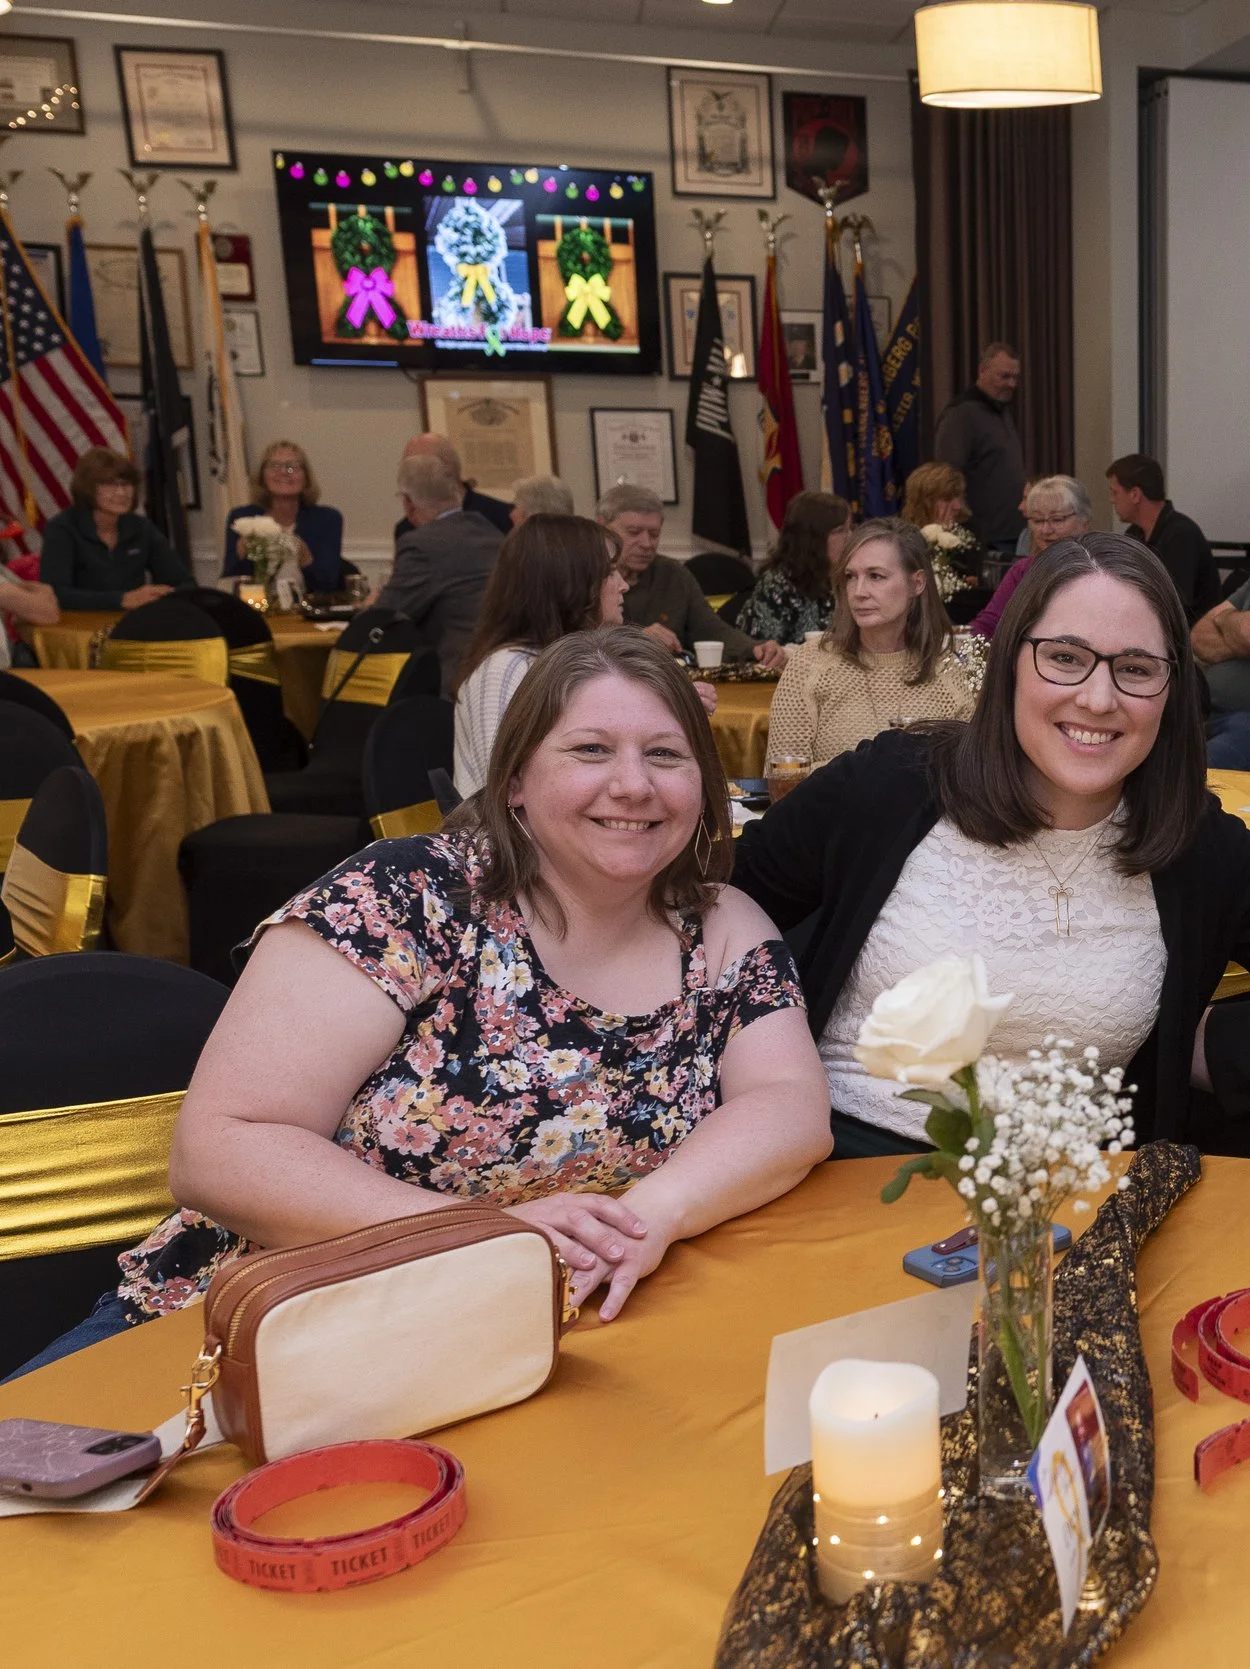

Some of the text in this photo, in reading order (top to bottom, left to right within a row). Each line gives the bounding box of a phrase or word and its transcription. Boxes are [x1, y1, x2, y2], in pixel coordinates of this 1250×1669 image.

[412, 1512, 450, 1550] TICKET
[249, 1559, 297, 1581] TICKET
[331, 1547, 389, 1577] TICKET
